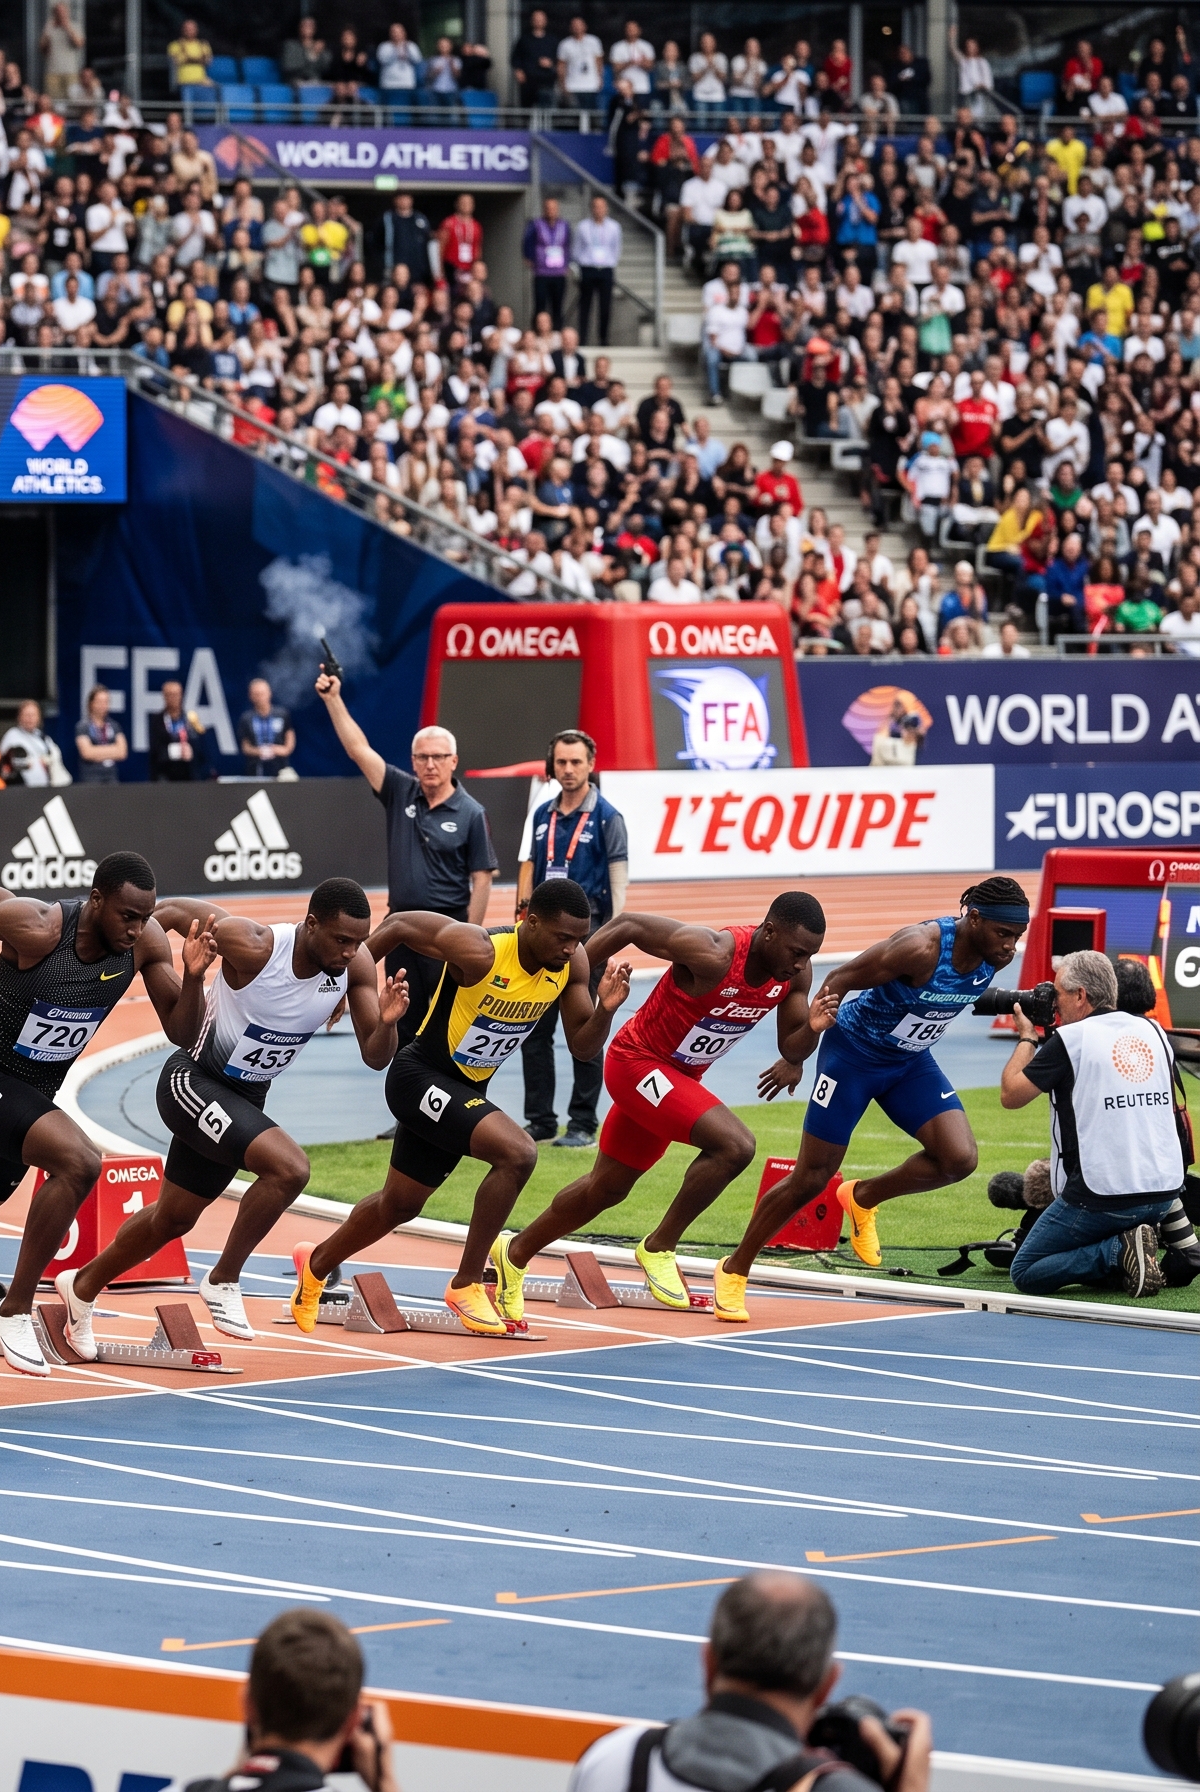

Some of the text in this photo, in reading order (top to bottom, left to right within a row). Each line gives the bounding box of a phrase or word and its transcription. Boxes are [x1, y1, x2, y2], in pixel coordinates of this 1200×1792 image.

[276, 140, 529, 171] WORLD ATHLETICS
[26, 457, 89, 477] WORLD
[479, 626, 581, 657] OMEGA
[680, 624, 779, 656] OMEGA
[703, 703, 763, 742] FFA
[945, 693, 1200, 746] WORLD A
[1, 855, 97, 890] adidas
[204, 848, 303, 882] adidas
[31, 1021, 88, 1048] 720
[467, 1034, 520, 1058] 219
[242, 1047, 296, 1070] 453
[642, 1075, 661, 1100] 7
[816, 1079, 829, 1101] 8
[428, 1090, 443, 1113] 6
[1104, 1091, 1170, 1111] REUTERS
[204, 1110, 223, 1135] 5
[106, 1165, 160, 1184] OMEGA
